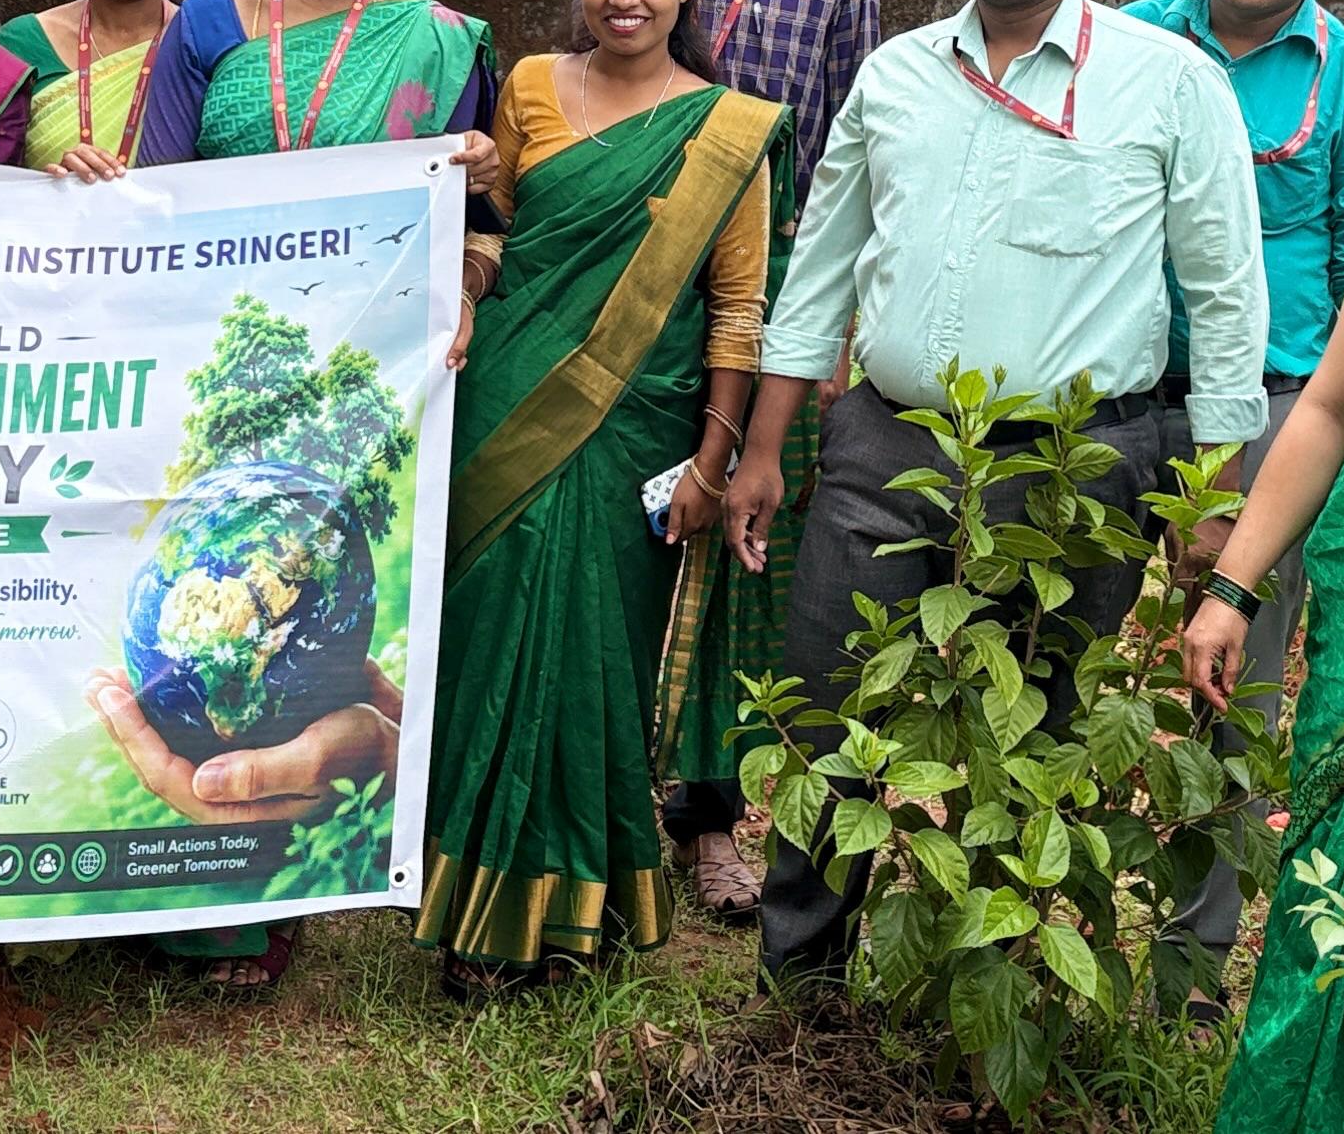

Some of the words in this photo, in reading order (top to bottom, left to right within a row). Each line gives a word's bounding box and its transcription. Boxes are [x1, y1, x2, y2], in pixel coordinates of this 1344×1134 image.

[4, 243, 185, 275] INSTITUTE
[194, 226, 351, 269] SRINGERI
[128, 840, 165, 856] Small
[167, 838, 216, 855] Actions
[219, 836, 259, 851] Today,
[126, 862, 179, 877] Greener
[183, 858, 249, 874] Tomorrow.
